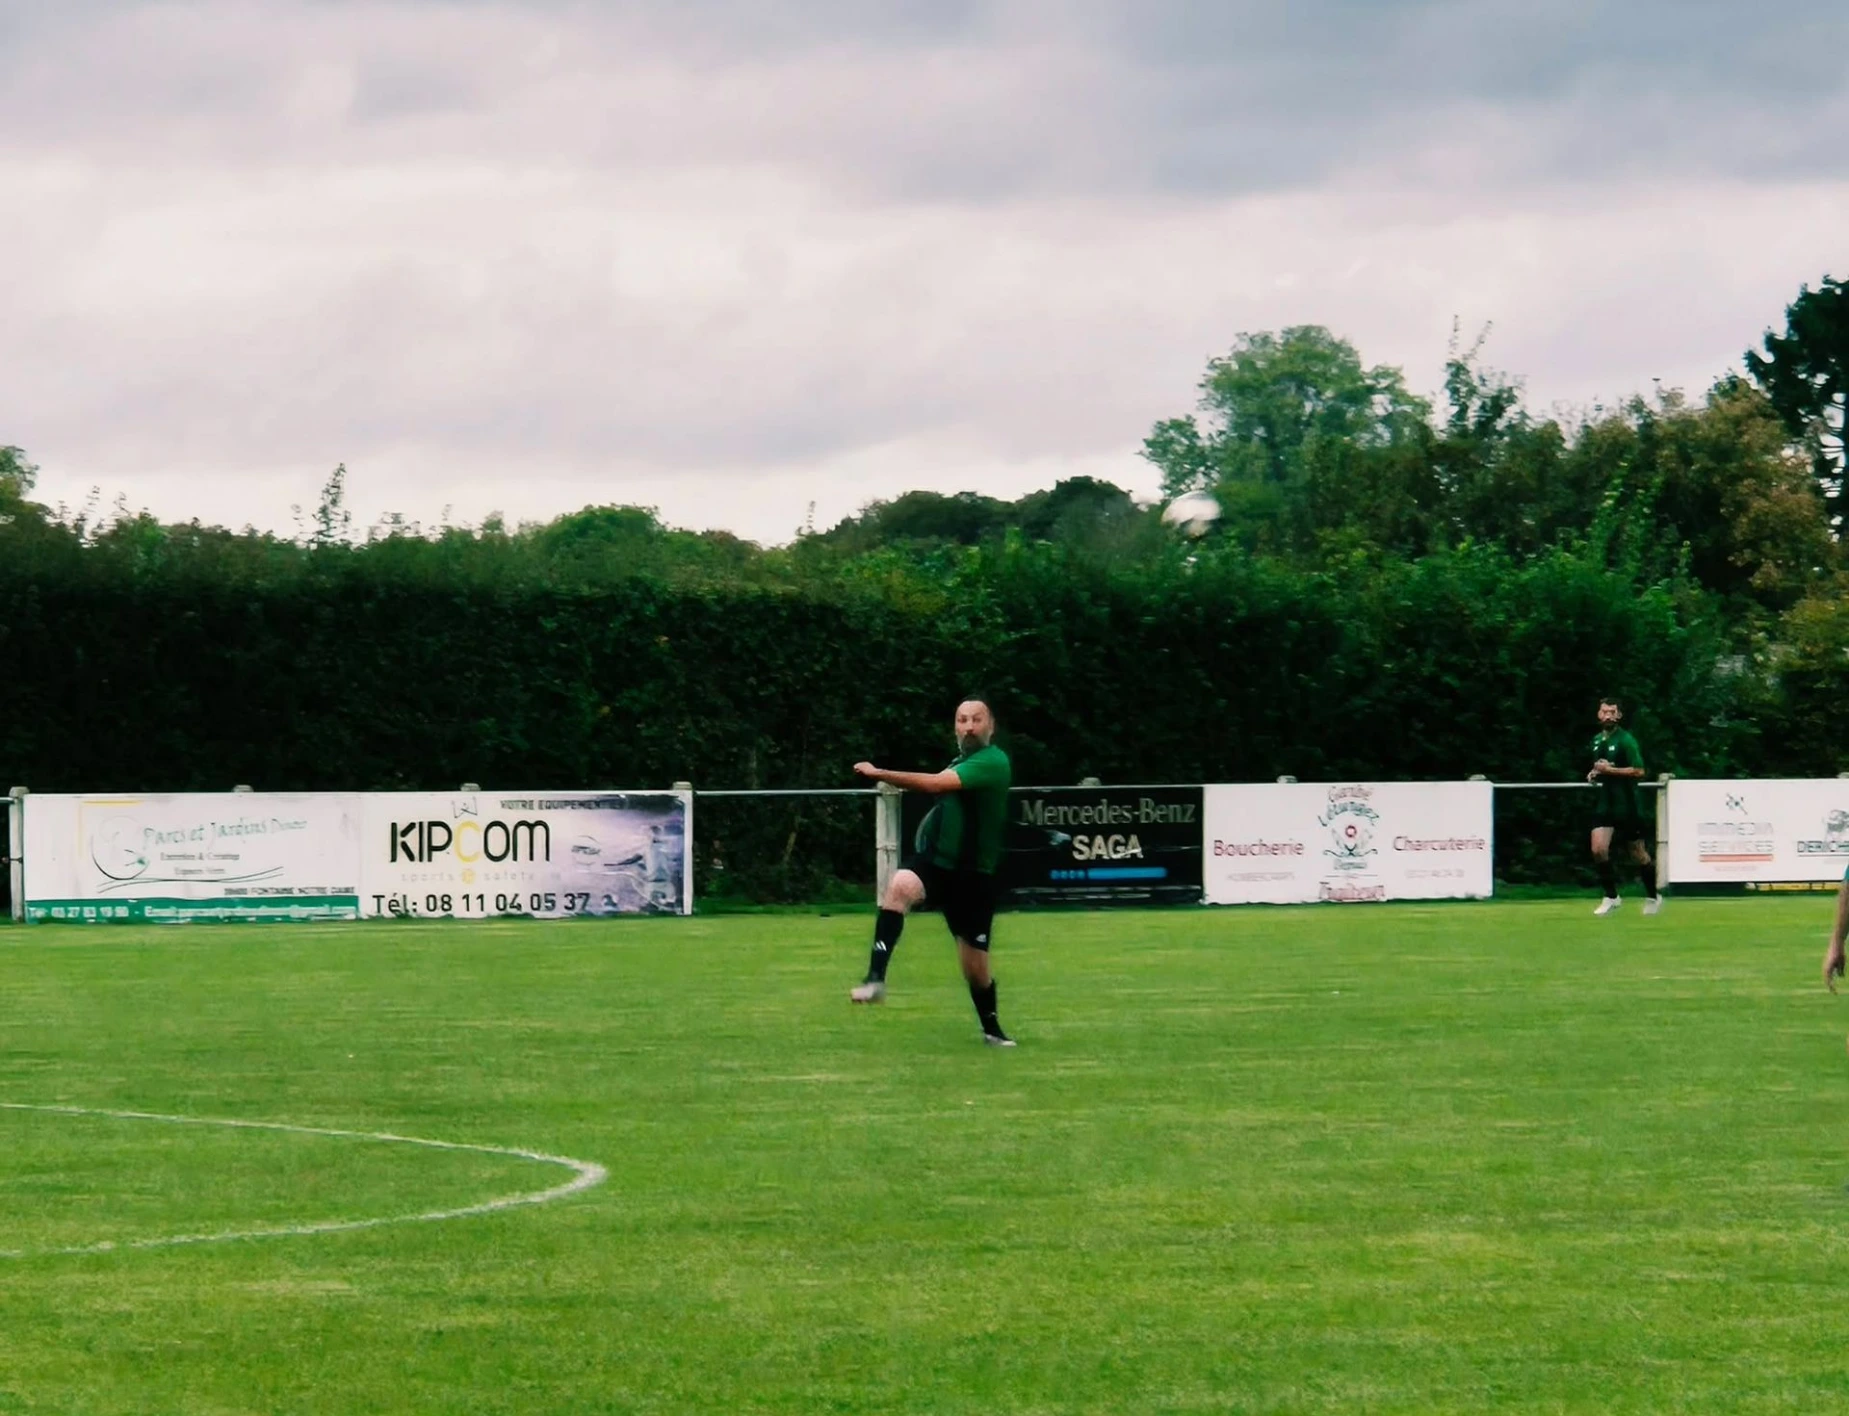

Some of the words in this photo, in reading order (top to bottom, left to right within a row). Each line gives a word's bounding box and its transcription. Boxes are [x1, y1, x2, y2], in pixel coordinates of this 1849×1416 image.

[1021, 798, 1196, 825] Mercedes-Benz
[1072, 834, 1144, 861] SAGA
[1213, 839, 1304, 856] Boucherie
[1393, 835, 1486, 851] Charcuterie
[372, 893, 417, 914] Tél:
[426, 895, 452, 911] 08
[461, 894, 485, 912] 11
[495, 893, 522, 911] 04
[530, 893, 556, 911] 05
[564, 893, 590, 911] 37
